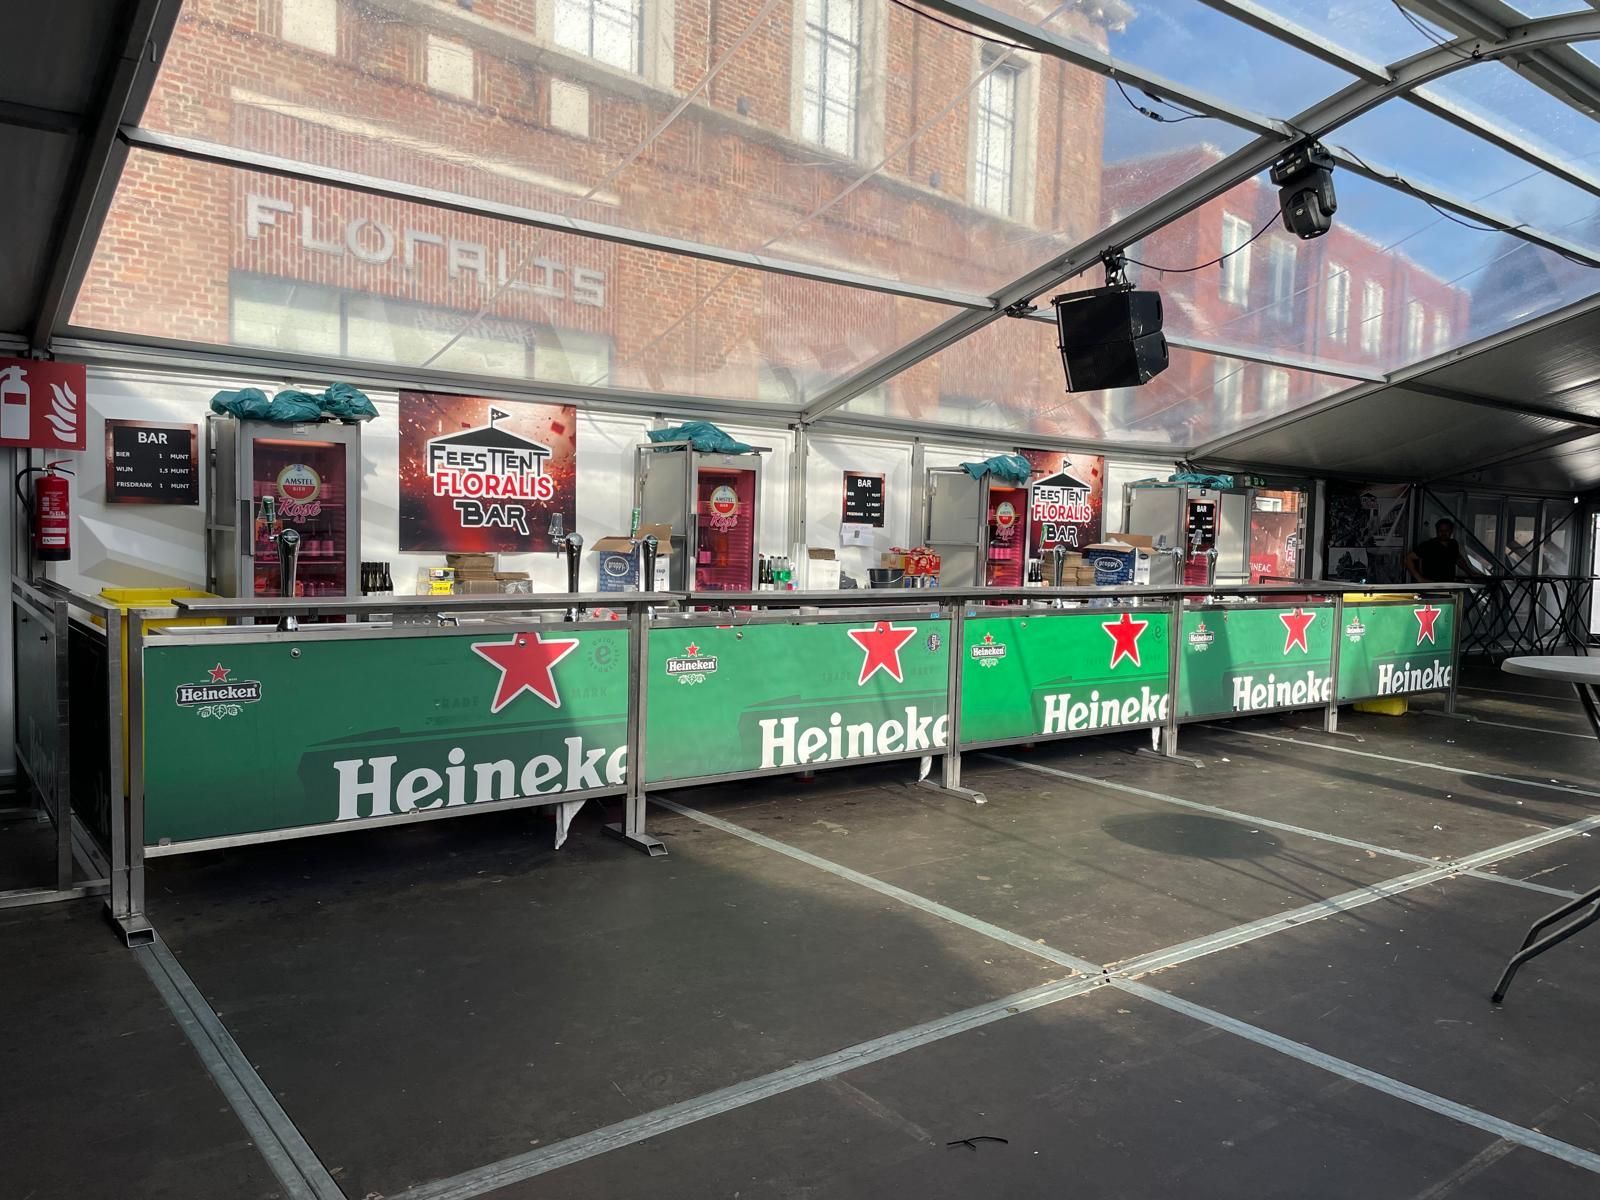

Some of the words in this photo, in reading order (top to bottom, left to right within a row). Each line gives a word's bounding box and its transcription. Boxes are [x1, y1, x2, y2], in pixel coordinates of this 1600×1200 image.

[138, 431, 168, 444] BAR
[436, 472, 551, 498] FLORALIS
[857, 479, 872, 488] BAR
[278, 496, 321, 516] Rosé
[1034, 504, 1091, 521] FLORALIS
[1196, 505, 1207, 513] BAR
[455, 501, 529, 534] BAR
[1046, 524, 1078, 547] BAR
[1250, 563, 1272, 573] INEAC
[973, 645, 1005, 657] Heineken
[668, 659, 716, 672] Heineken
[180, 685, 258, 702] Heineken
